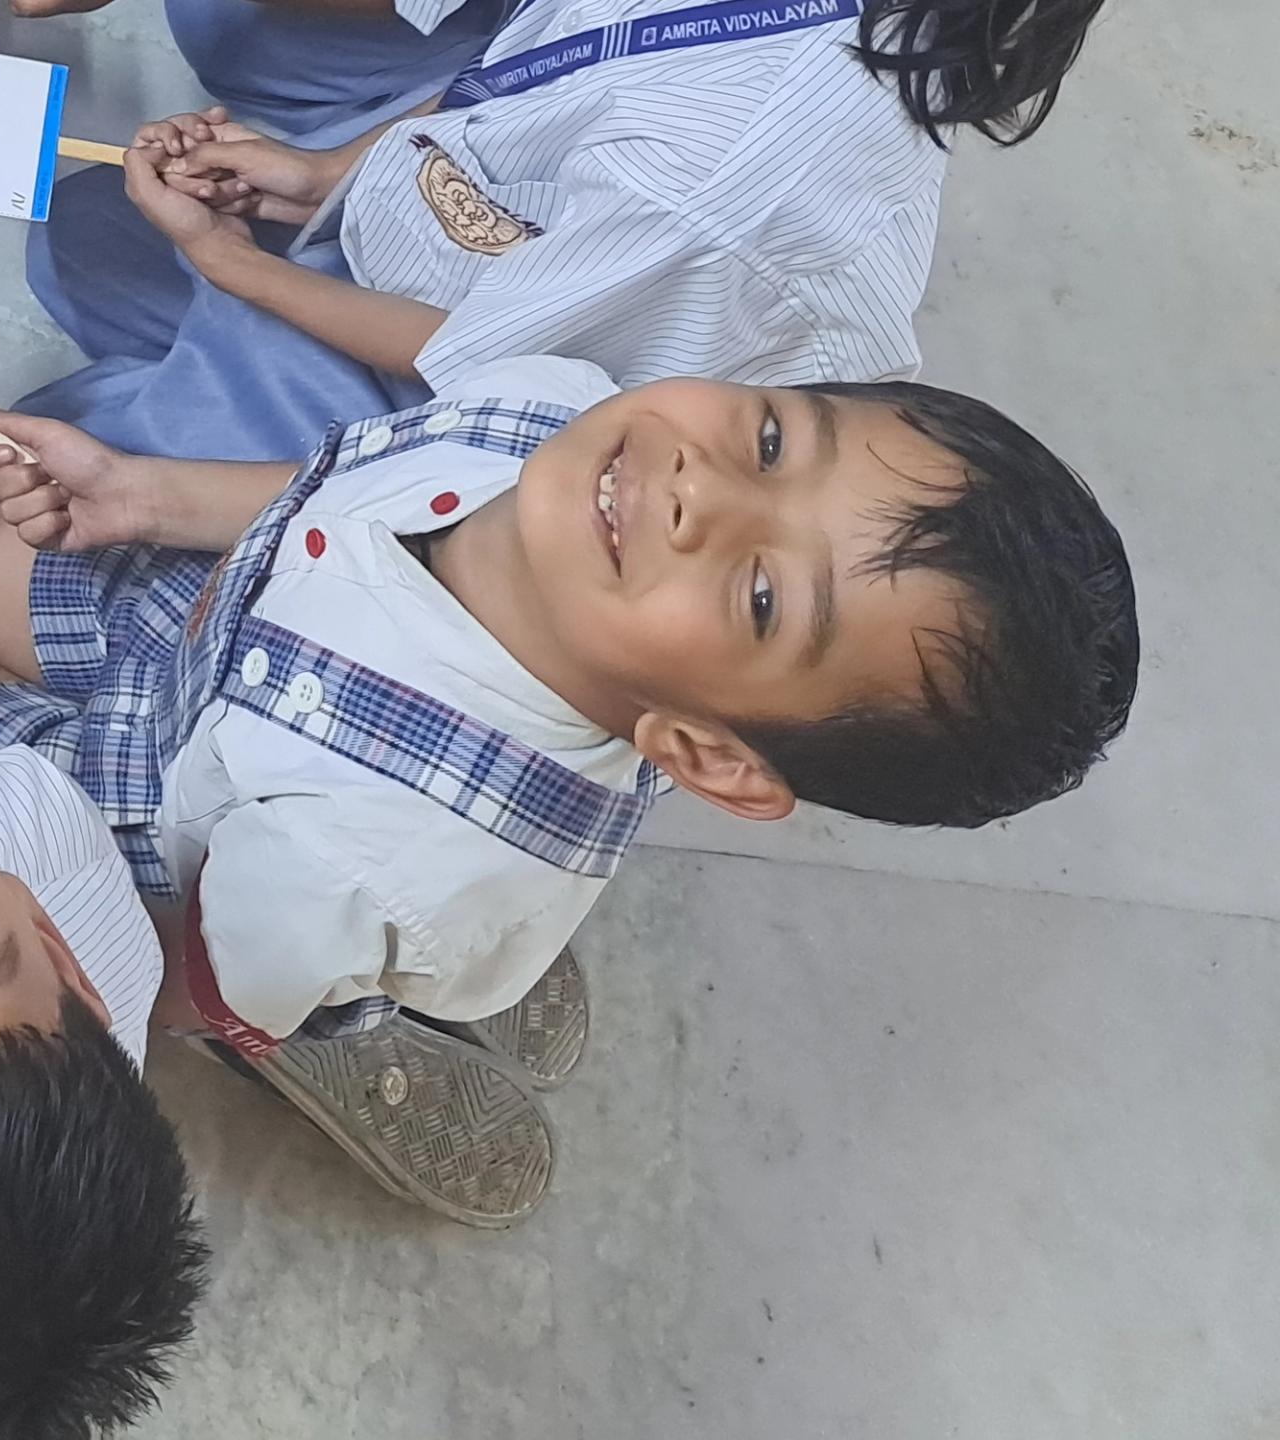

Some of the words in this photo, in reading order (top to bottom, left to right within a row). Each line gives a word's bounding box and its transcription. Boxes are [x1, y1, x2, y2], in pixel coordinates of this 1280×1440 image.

[661, 18, 722, 43] AMRITA
[495, 65, 528, 89] AMRITA
[526, 42, 594, 78] VIDYALAYAM
